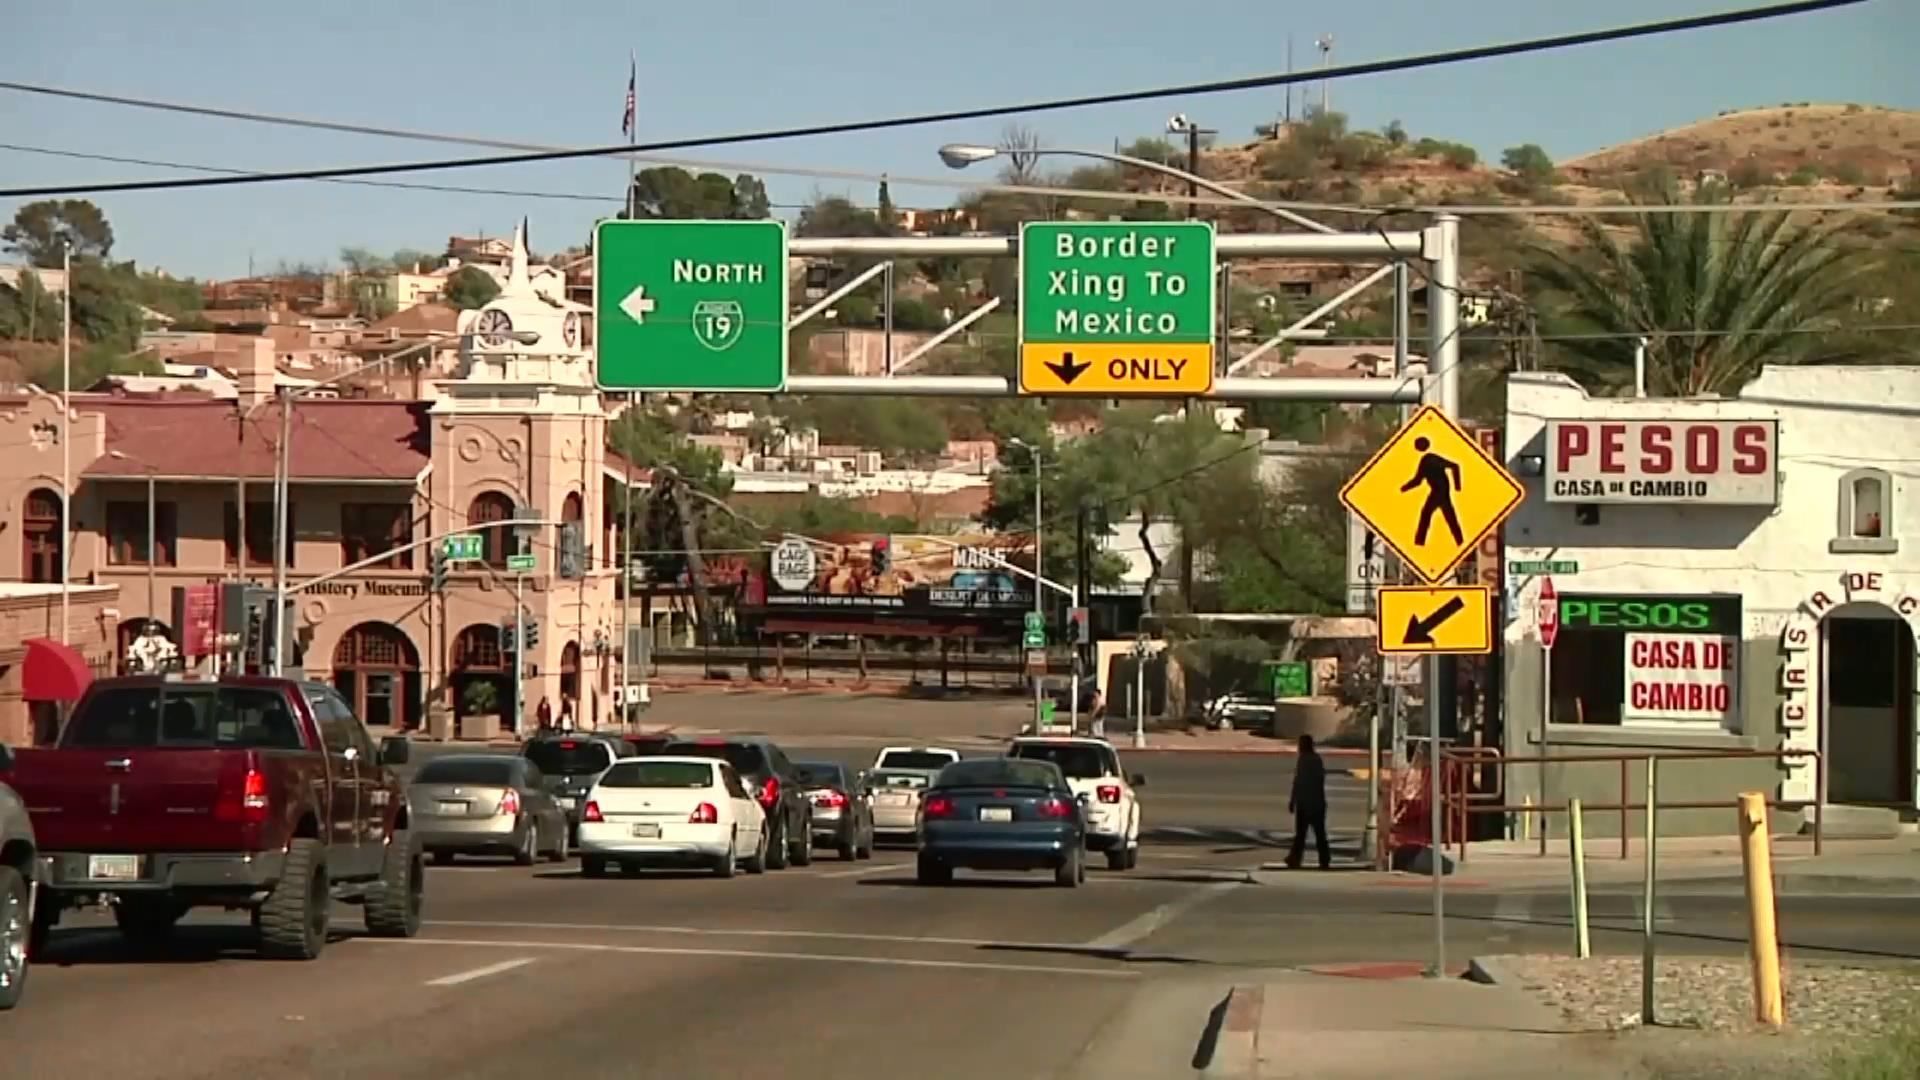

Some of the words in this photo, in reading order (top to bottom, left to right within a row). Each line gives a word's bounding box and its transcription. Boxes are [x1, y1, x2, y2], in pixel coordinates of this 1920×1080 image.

[1056, 231, 1176, 258] Border
[674, 259, 763, 283] NORTH
[1048, 268, 1125, 302] Xing
[1145, 271, 1186, 296] To
[705, 316, 731, 340] 19
[1056, 307, 1176, 334] Mexico
[1108, 358, 1188, 381] ONLY
[1557, 424, 1767, 474] PESOS
[1554, 480, 1605, 496] CASA
[1610, 482, 1624, 493] DE
[1629, 480, 1707, 496] CAMBIO
[1849, 572, 1884, 591] DE
[1560, 601, 1709, 628] PESOS
[1631, 640, 1697, 669] CASA
[1703, 642, 1733, 670] DE
[1631, 682, 1729, 712] CAMBIO
